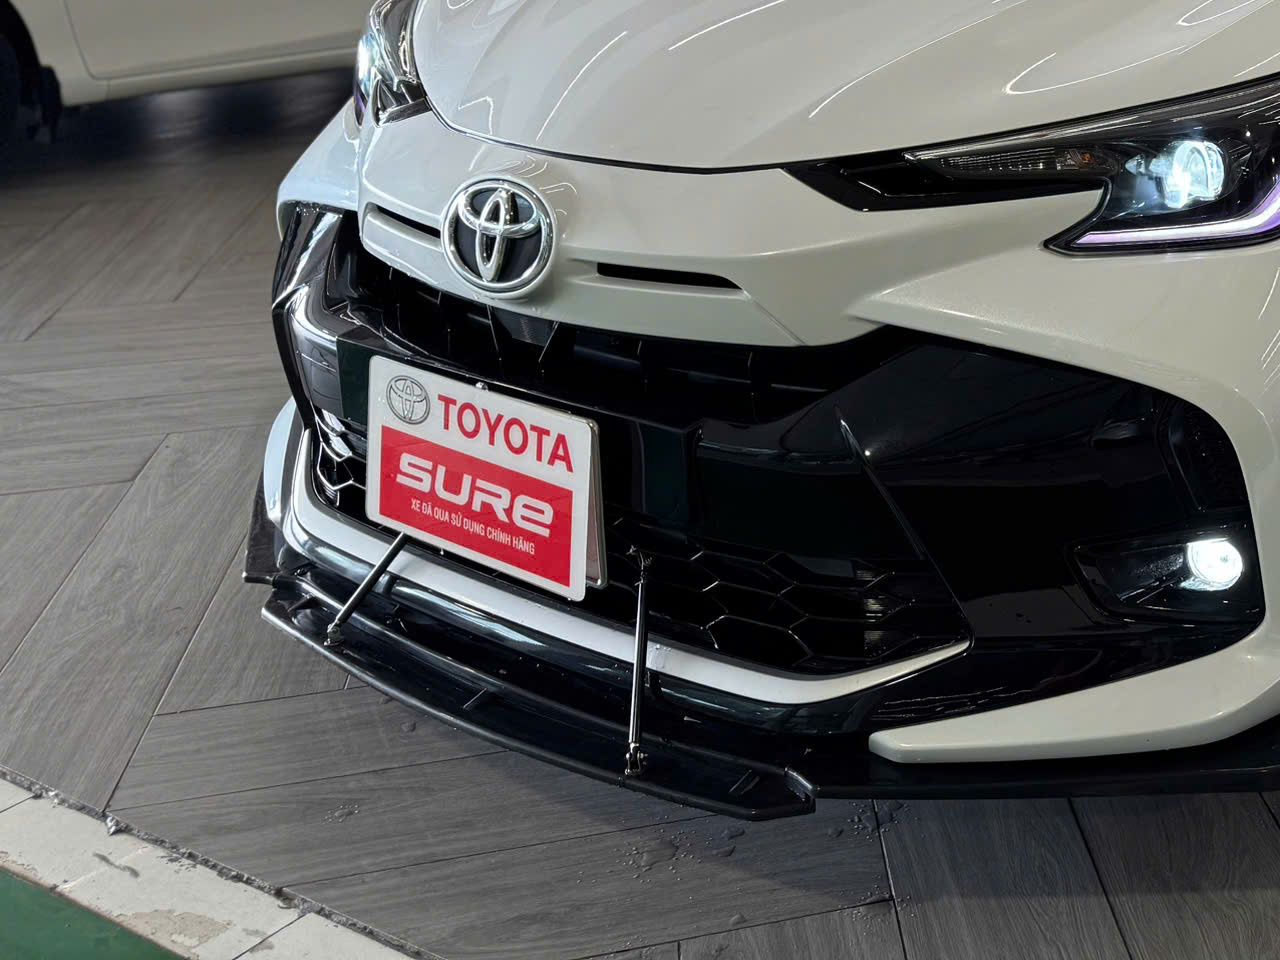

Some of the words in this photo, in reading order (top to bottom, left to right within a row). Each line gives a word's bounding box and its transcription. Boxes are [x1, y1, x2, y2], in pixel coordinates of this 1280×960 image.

[437, 393, 574, 473] TOYOTA
[411, 498, 421, 512] XE
[422, 501, 432, 516] ĐÃ
[434, 506, 449, 523] QUA
[451, 511, 462, 527] SỬ
[463, 519, 485, 536] DỤNG
[486, 527, 511, 545] CHÍNH
[512, 535, 535, 555] HÃNG
